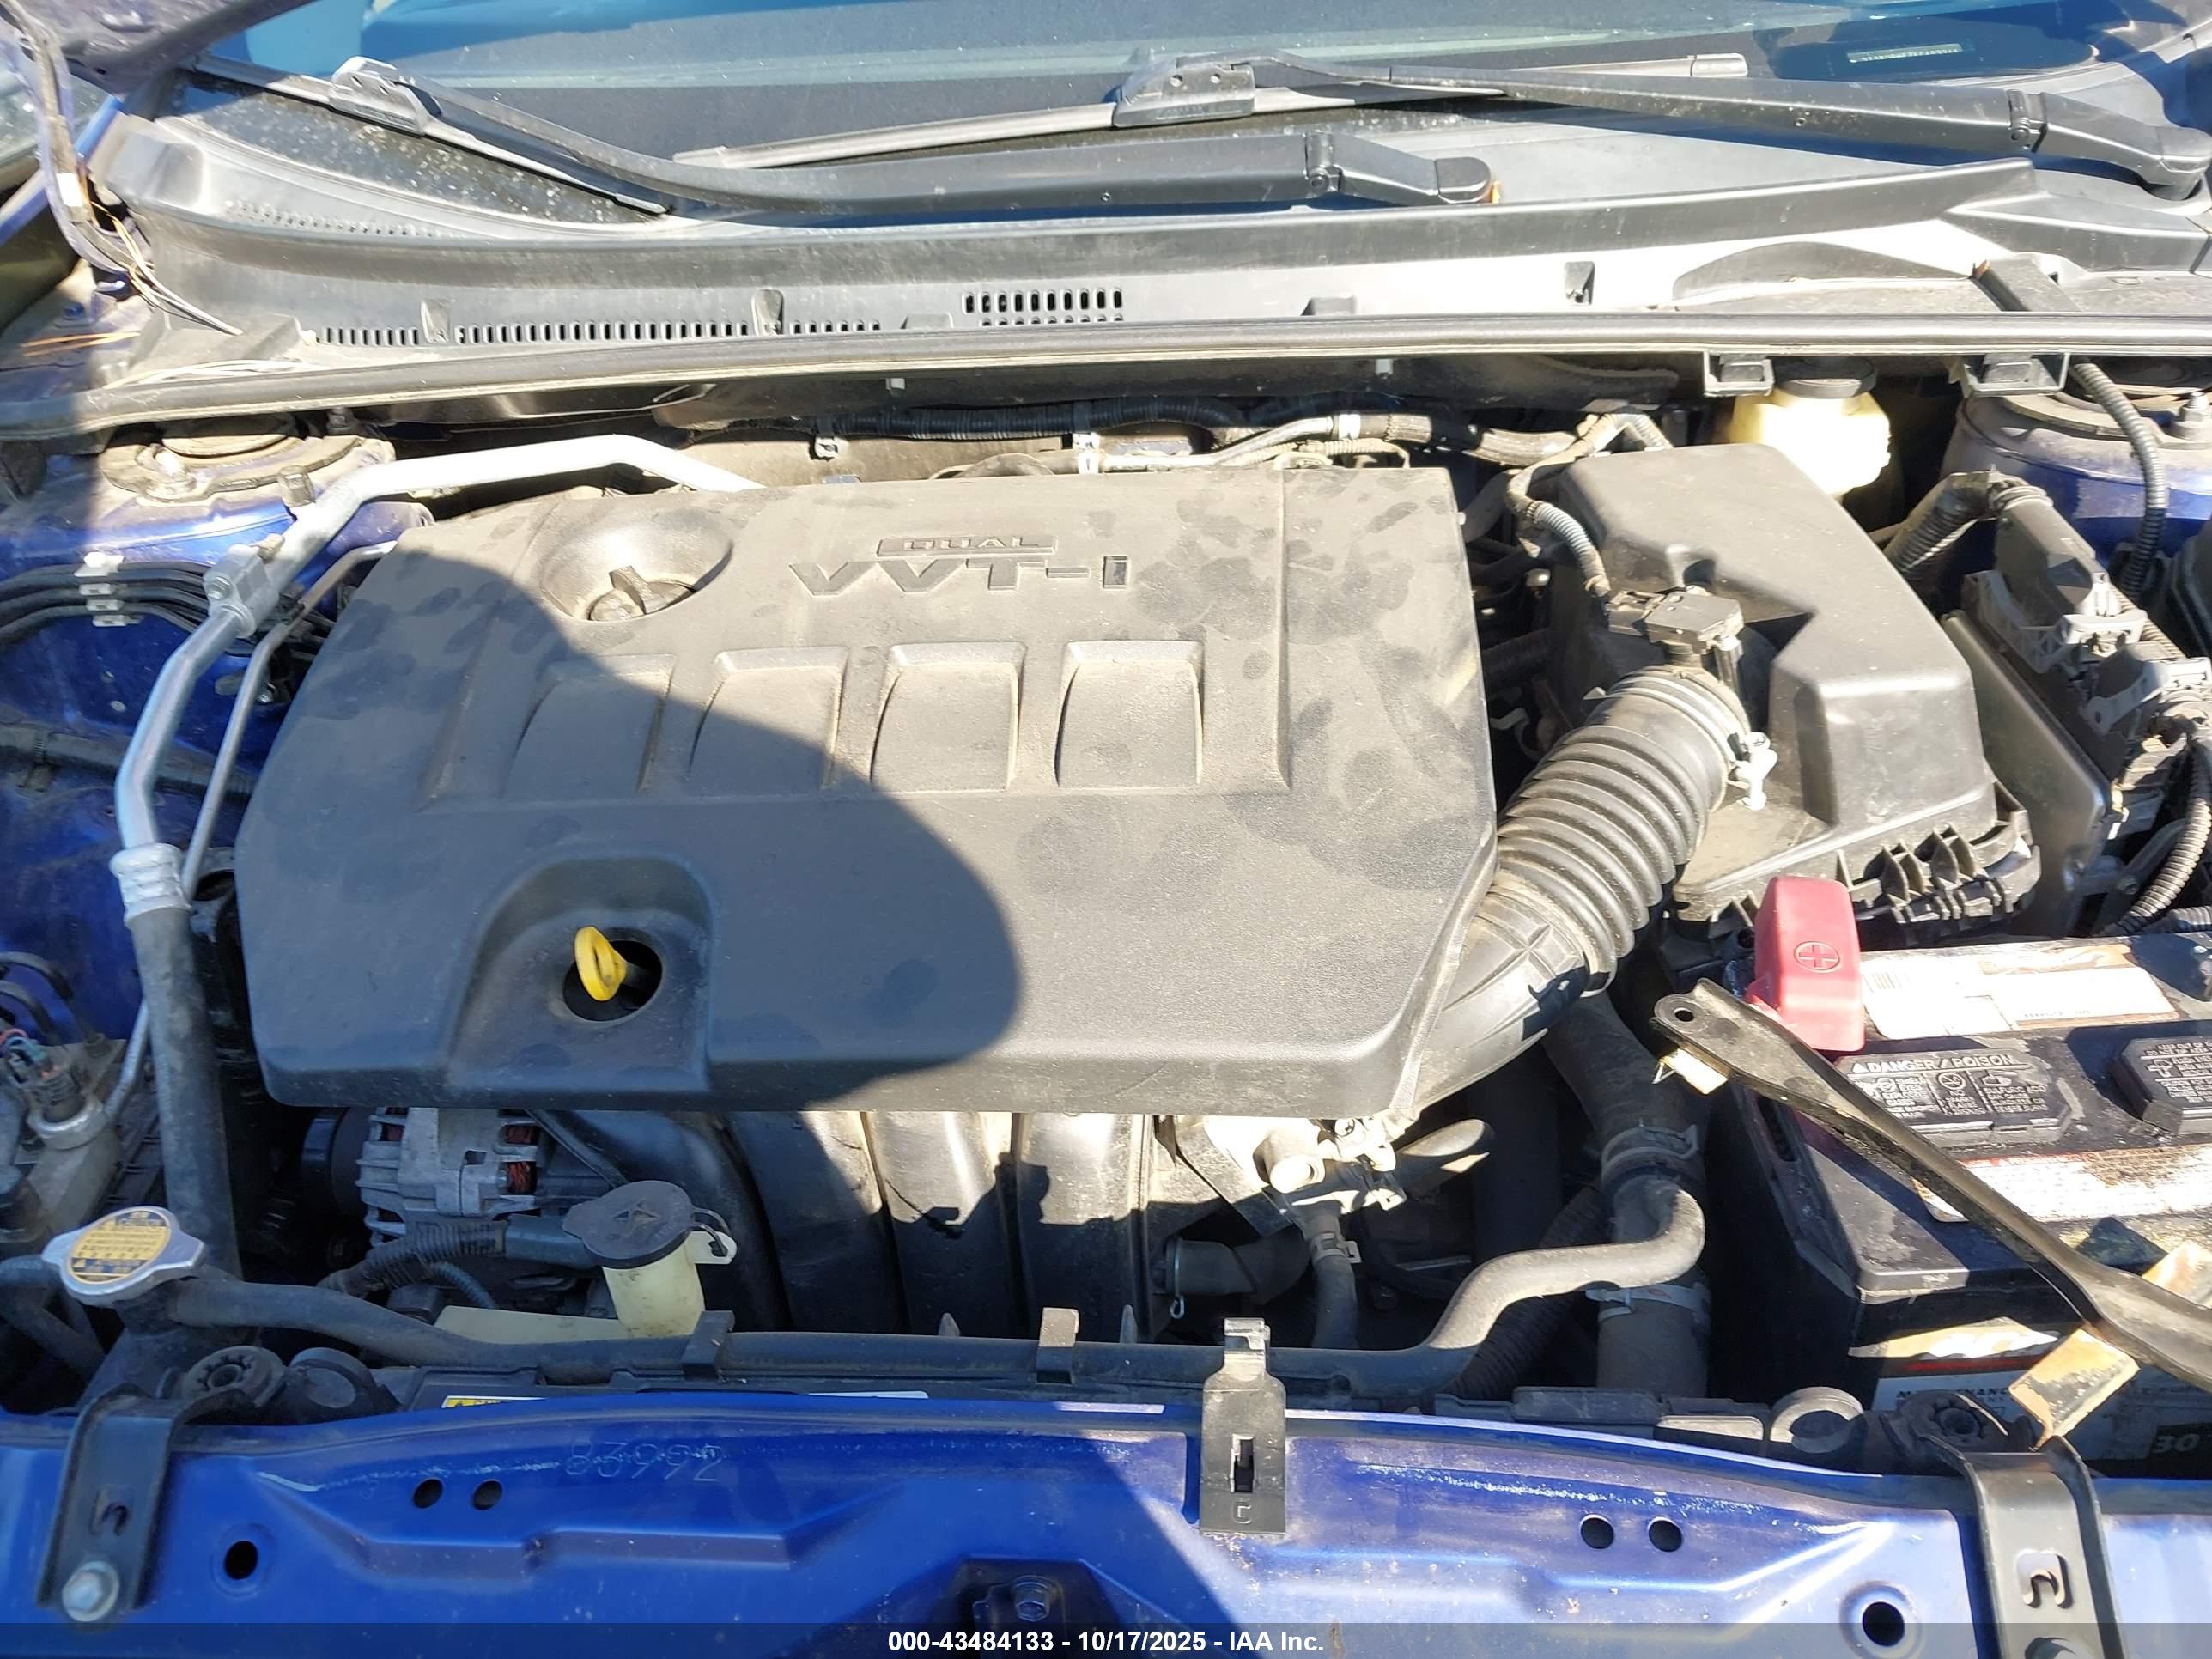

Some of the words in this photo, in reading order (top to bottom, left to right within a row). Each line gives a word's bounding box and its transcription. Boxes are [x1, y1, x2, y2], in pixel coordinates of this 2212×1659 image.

[903, 535, 1041, 550] DUAL
[1867, 1060, 1940, 1073] DANGER
[1951, 1054, 2014, 1067] POISON
[1895, 1076, 1926, 1085] SHIELD
[1899, 1083, 1923, 1091] EYES
[1983, 1086, 2027, 1095] SULFURIC
[2026, 1085, 2047, 1094] ACID
[2153, 1433, 2200, 1454] 30
